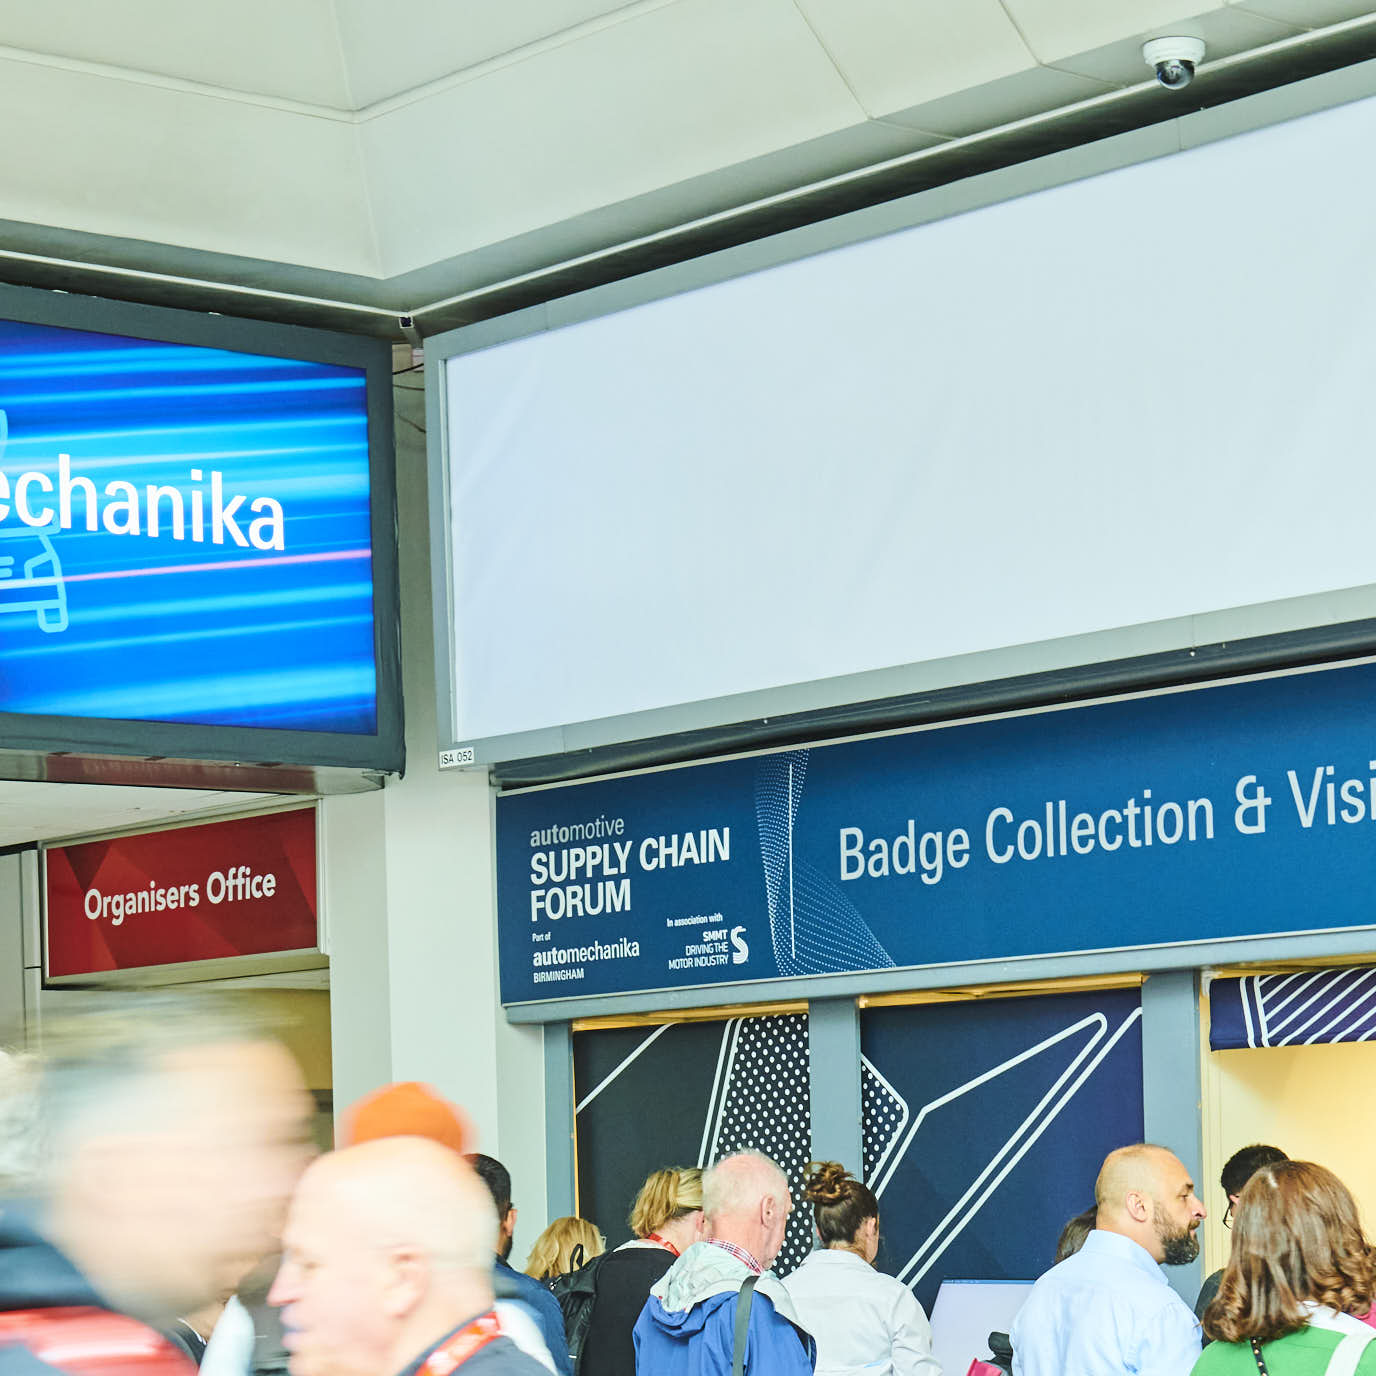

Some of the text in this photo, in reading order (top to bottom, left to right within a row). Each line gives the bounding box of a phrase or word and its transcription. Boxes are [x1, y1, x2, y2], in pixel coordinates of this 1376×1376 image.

[457, 750, 472, 762] 052
[530, 814, 624, 847] automotive
[839, 819, 970, 886] Badge
[985, 789, 1215, 864] Collection
[1234, 775, 1272, 835] &
[530, 827, 730, 885] SUPPLY CHAIN
[84, 865, 276, 926] Organisers Office
[531, 878, 631, 922] FORUM
[667, 912, 723, 927] In association with
[532, 931, 551, 942] Part of
[703, 929, 728, 942] SMMT
[533, 937, 640, 966] automechanika
[686, 942, 728, 956] DRIVING THE
[669, 954, 729, 970] MOTOR INDUSTRY
[533, 968, 584, 983] BIRMINGHAM
